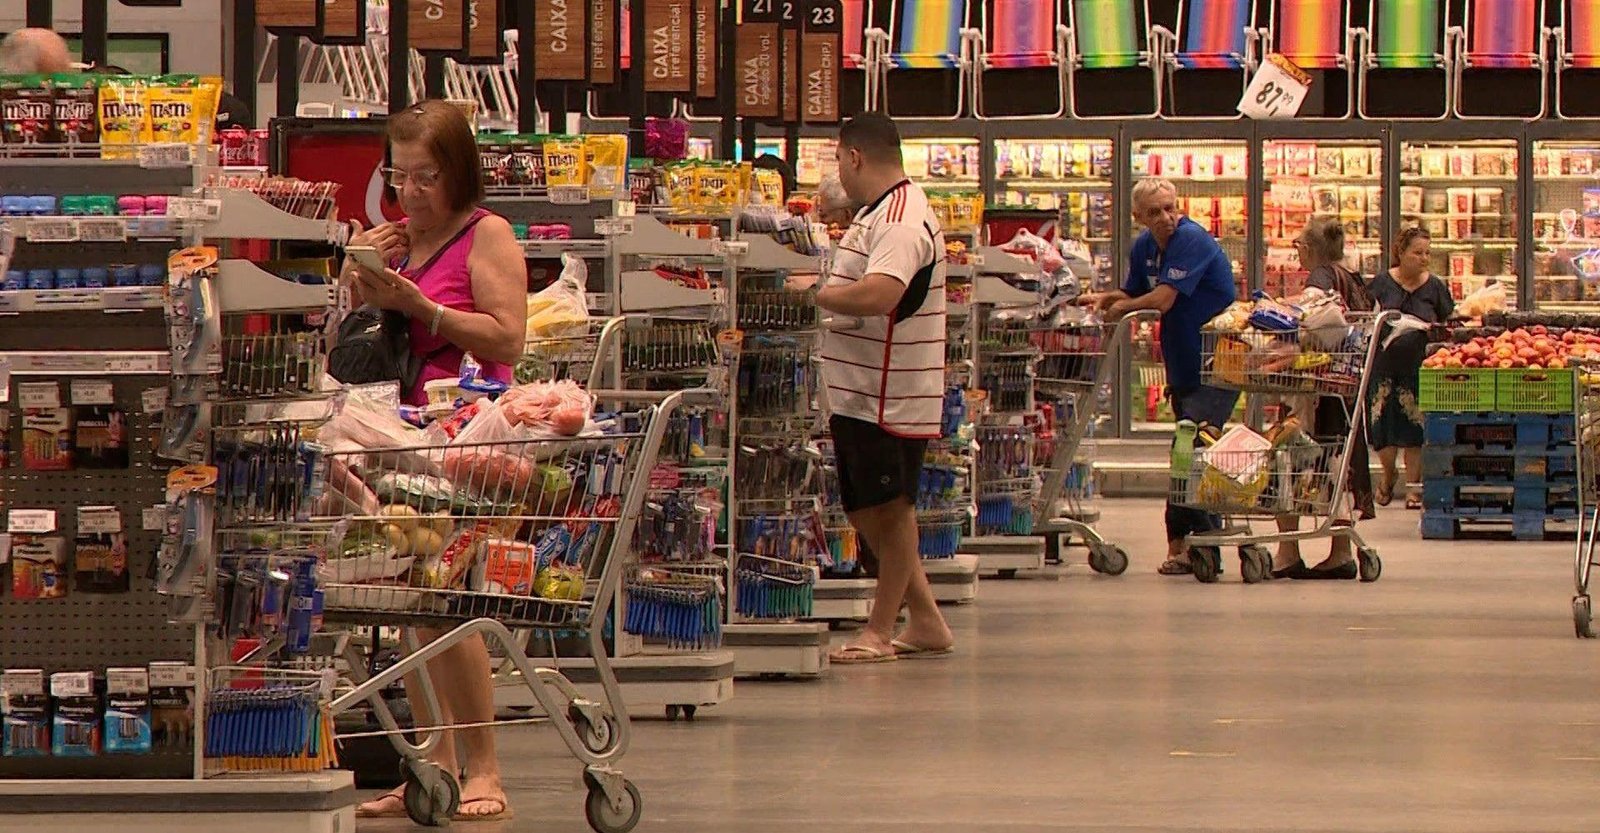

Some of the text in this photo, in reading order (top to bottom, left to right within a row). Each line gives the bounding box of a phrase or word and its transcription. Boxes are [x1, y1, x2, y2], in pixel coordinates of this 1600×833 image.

[753, 0, 772, 13] 21
[812, 8, 835, 25] 23
[593, 0, 606, 69] preferenci
[653, 26, 669, 78] CAIXA
[670, 3, 681, 77] preferencial
[744, 57, 758, 105] CAIXA
[807, 69, 822, 115] CAIXA
